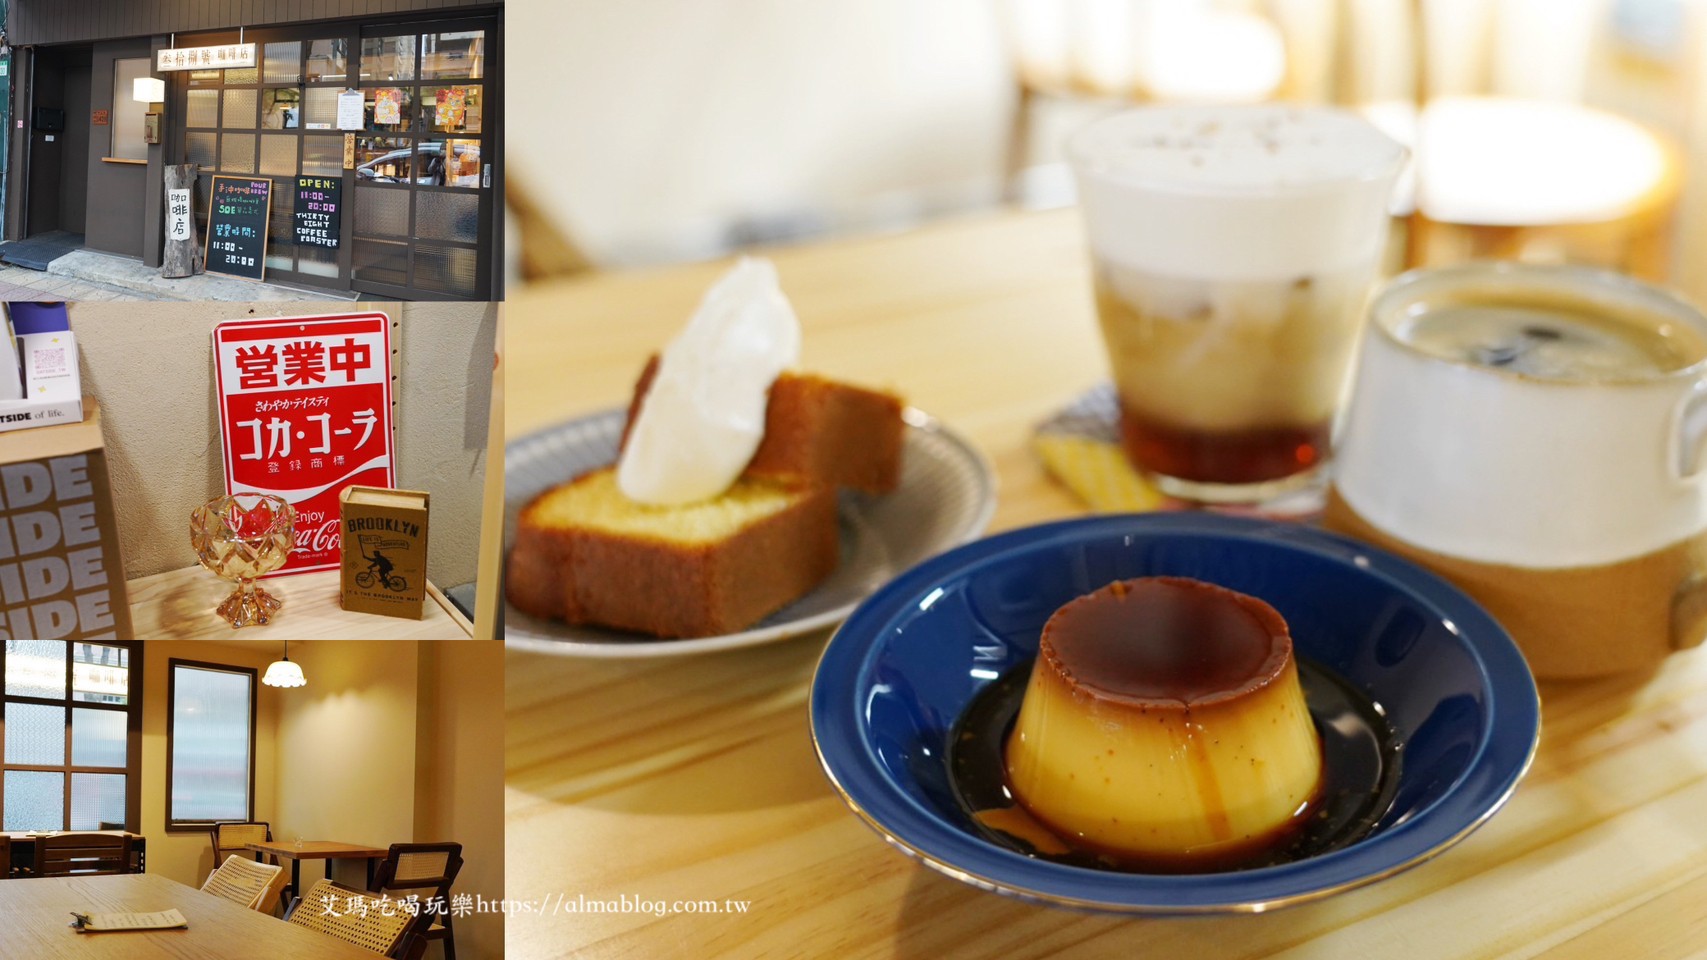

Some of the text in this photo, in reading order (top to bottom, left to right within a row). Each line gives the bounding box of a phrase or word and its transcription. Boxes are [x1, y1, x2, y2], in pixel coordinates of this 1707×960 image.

[307, 202, 336, 212] 20:00
[170, 193, 188, 235] 咖啡店
[296, 212, 330, 221] THIRTY
[303, 220, 330, 228] EIGHT
[296, 227, 328, 238] COFFEE
[300, 235, 338, 247] ROASTER
[225, 254, 255, 267] 20:00
[235, 337, 372, 390] 営業中
[34, 410, 45, 419] of
[347, 517, 420, 538] BROOKLYN
